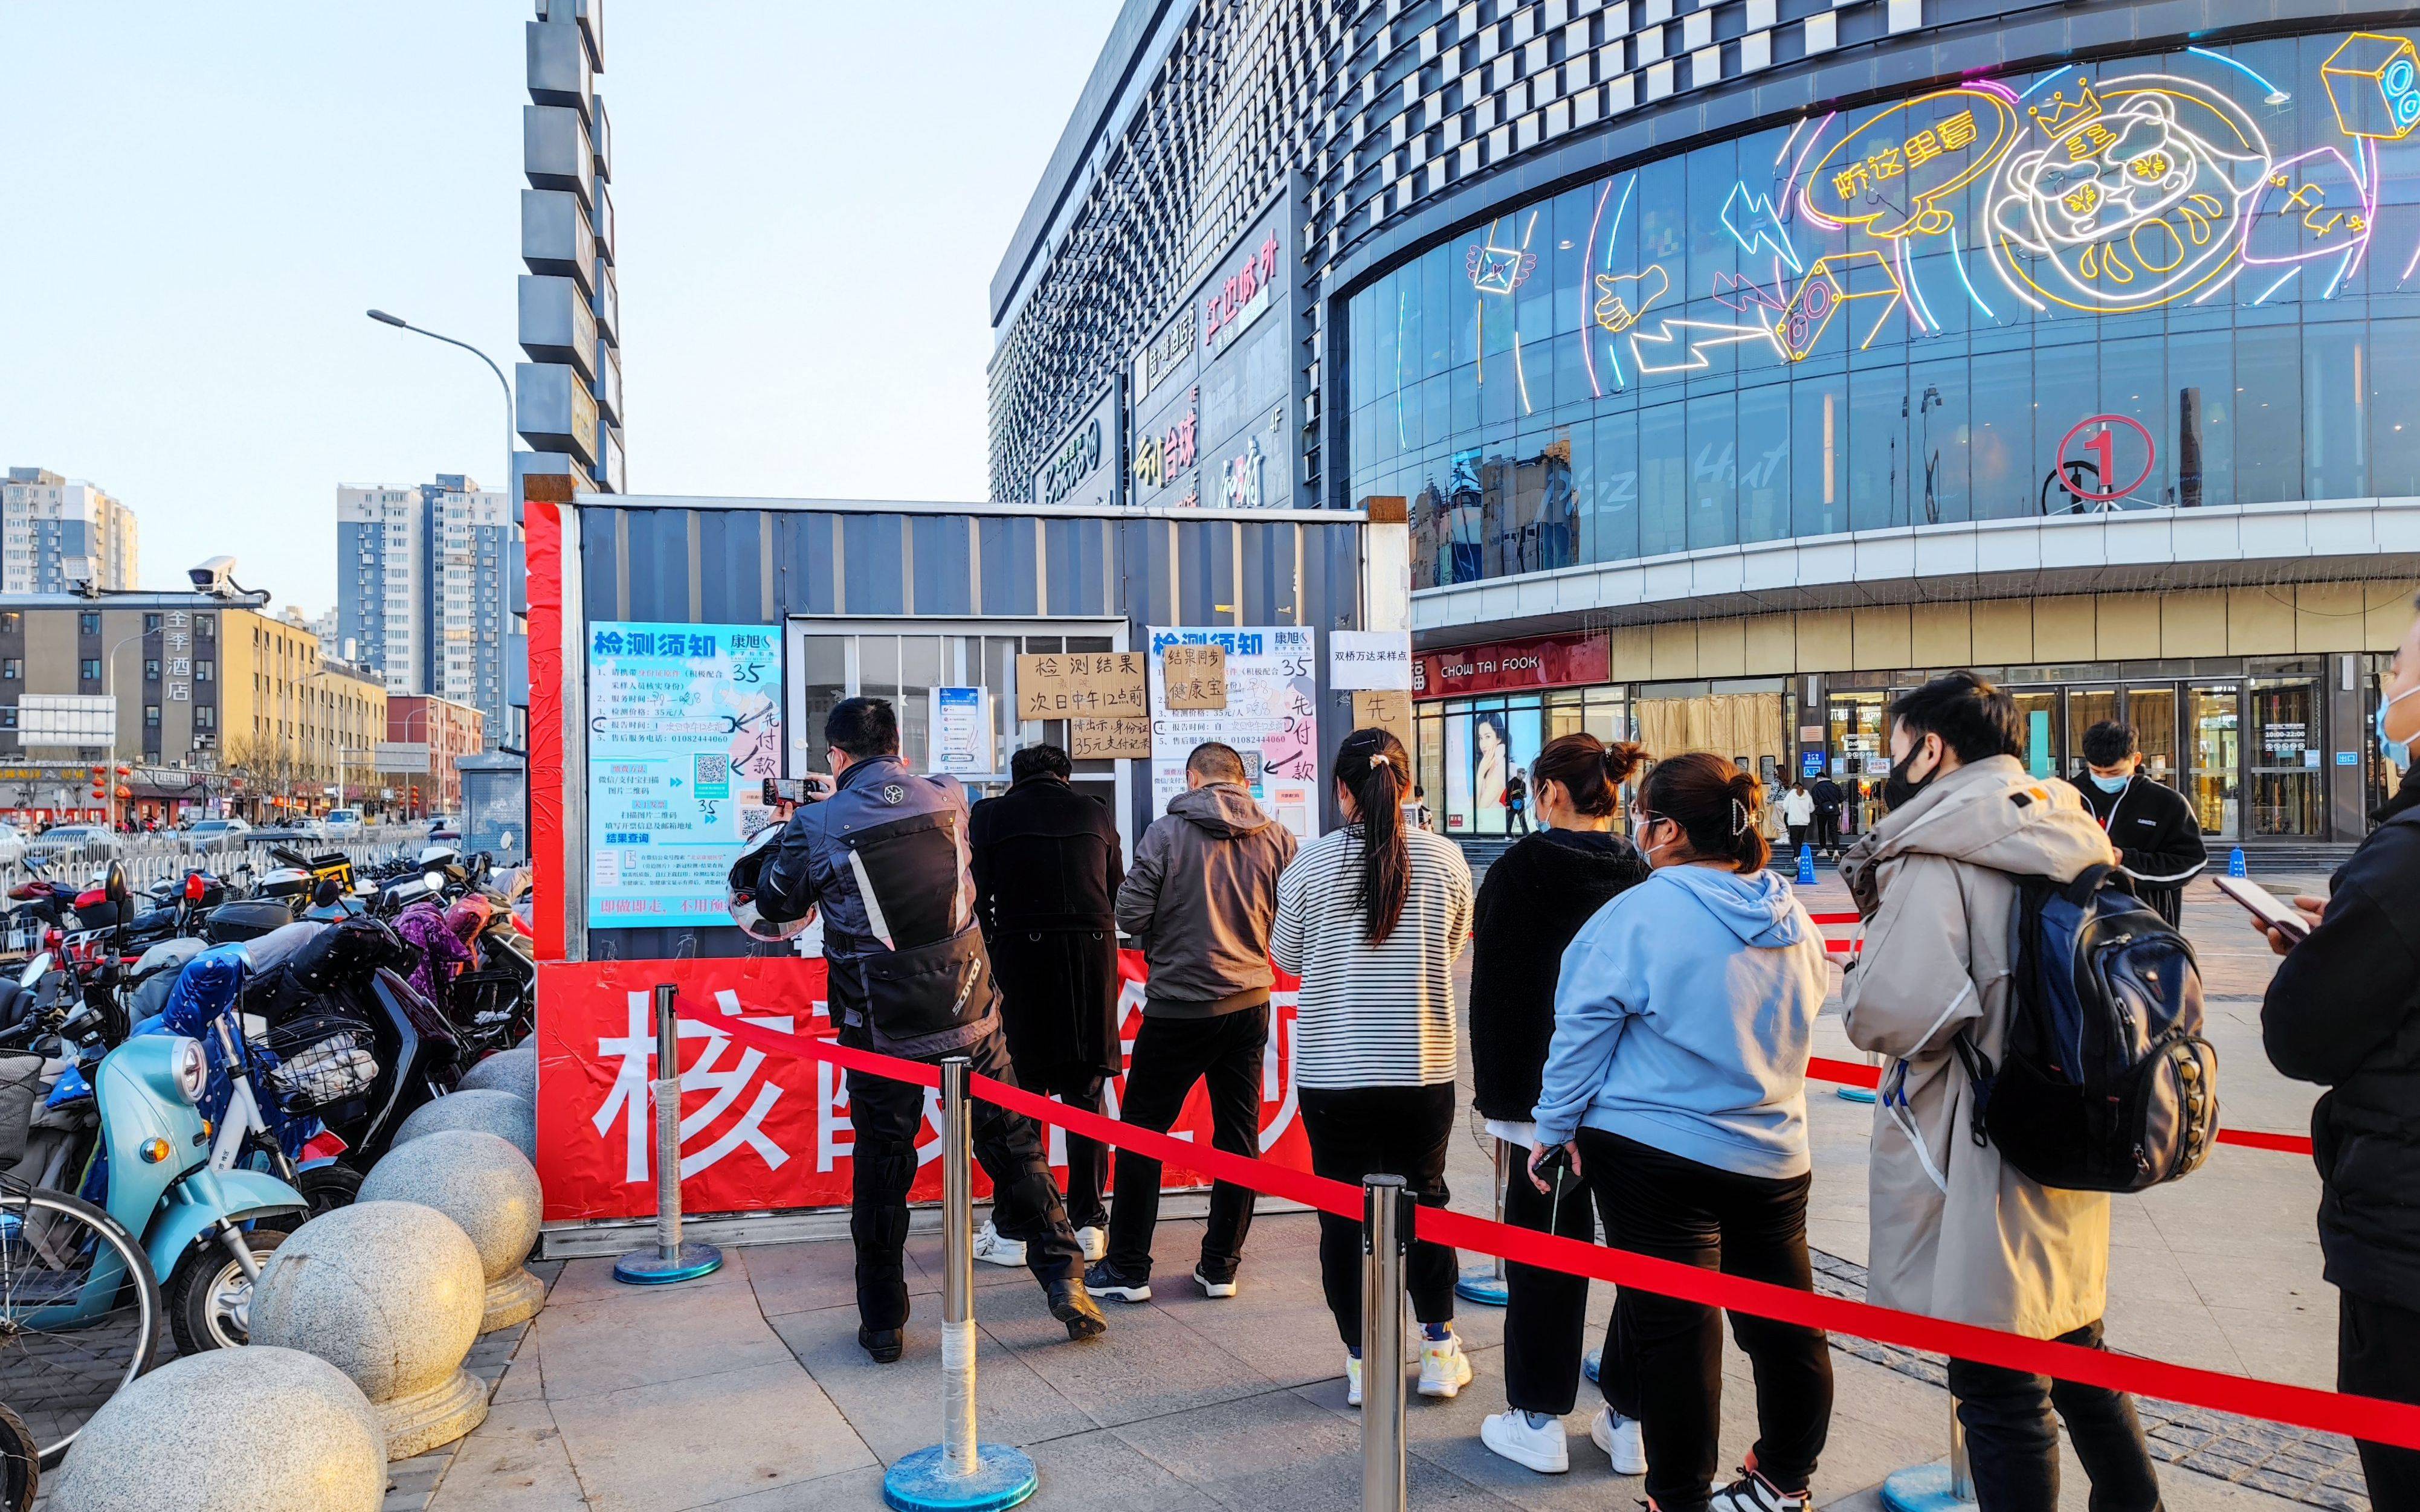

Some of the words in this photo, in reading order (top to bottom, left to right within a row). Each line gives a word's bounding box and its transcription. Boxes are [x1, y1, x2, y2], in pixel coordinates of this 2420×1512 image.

[1205, 227, 1279, 347] 江边城外
[1269, 407, 1283, 433] 4F
[594, 631, 716, 658] 检测须知
[731, 634, 760, 648] 康旭
[1275, 632, 1299, 644] 康旭
[166, 610, 190, 701] 全季酒店
[1035, 654, 1138, 677] 检测结果
[1167, 648, 1219, 667] 结果同步
[1335, 651, 1407, 661] 双桥万达采样点
[733, 662, 766, 683] 35
[1282, 656, 1313, 677] 35
[1441, 663, 1474, 678] CHOW
[1477, 660, 1497, 674] TAI
[1502, 655, 1539, 672] FOOK
[1030, 685, 1144, 712] 次日中午12点前
[1169, 677, 1224, 701] 健康宝
[1366, 695, 1395, 722] 先
[753, 713, 779, 777] 先付款
[1074, 736, 1150, 756] 35元支付记录
[1292, 695, 1315, 782] 先付款
[598, 775, 660, 784] 微信/支付宝扫描
[608, 787, 650, 795] 图片二维码
[621, 811, 677, 820] 扫描图片二维码
[697, 799, 720, 814] 35
[606, 834, 650, 843] 结果查询
[679, 898, 730, 913] 不用预
